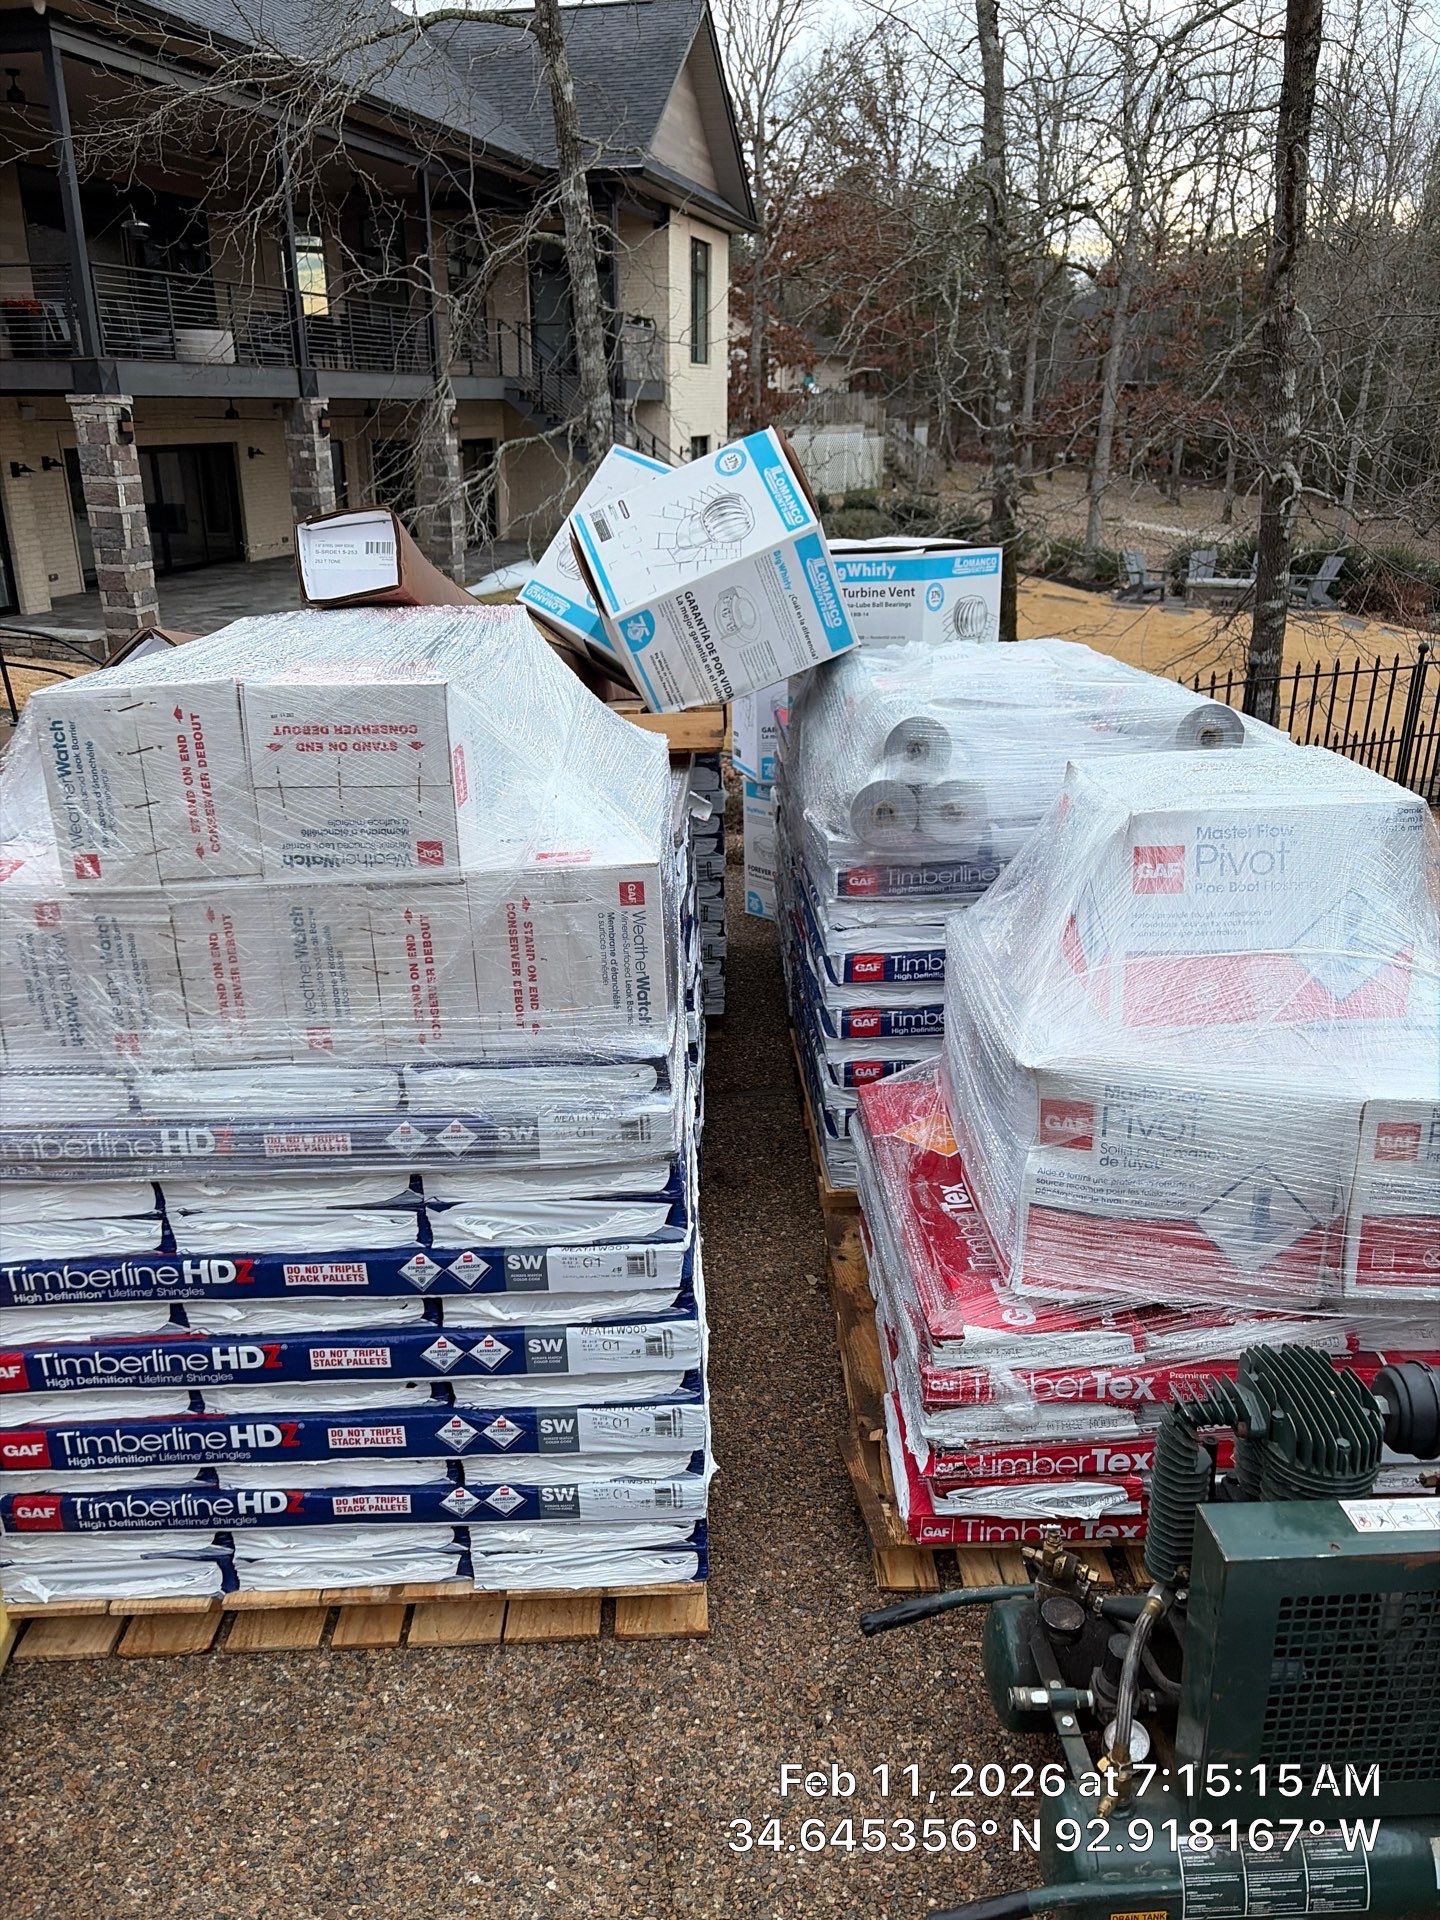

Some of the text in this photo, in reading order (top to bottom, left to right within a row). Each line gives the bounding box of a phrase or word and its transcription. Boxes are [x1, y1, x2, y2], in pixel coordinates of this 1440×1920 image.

[769, 465, 805, 524] LOMANCO
[954, 557, 997, 569] LOMANCO
[814, 557, 842, 628] LOMANCO
[842, 586, 916, 598] Turbine Vent
[526, 588, 567, 617] LOMANCO
[675, 594, 717, 684] La mejor garantía en el
[684, 591, 735, 701] GARANTÍA DE POR VIDA
[273, 724, 418, 736] CONSERVER DEBOUT
[68, 720, 84, 774] Leak Barrier
[296, 741, 398, 752] STAND ON END
[49, 719, 84, 850] WeatherWatch
[176, 734, 201, 834] STAND ON END
[190, 712, 221, 853] CONSERVER DEBOUT
[1257, 825, 1293, 838] Flow
[283, 852, 411, 868] WeatherWatch
[1194, 841, 1291, 877] Pivot
[886, 865, 1000, 885] Timberline
[1136, 863, 1184, 879] GAF
[849, 877, 876, 886] GAF
[1194, 882, 1260, 894] Pipe Boot
[627, 883, 638, 904] GAF
[888, 887, 906, 895] High
[222, 913, 238, 964] DEBOUT
[607, 912, 620, 957] Membrane
[208, 932, 224, 980] ON END
[405, 933, 419, 981] ON END
[506, 902, 525, 1029] CONSERVER DEBOUT
[523, 921, 540, 1011] STAND ON END
[632, 910, 653, 1027] WeatherWatch
[855, 963, 881, 973] GAF
[420, 914, 442, 1041] CONSERVER DEBOUT
[894, 972, 912, 981] High
[625, 979, 634, 999] Leak
[852, 1018, 879, 1028] GAF
[891, 1027, 909, 1035] High
[854, 1067, 881, 1077] GAF
[1044, 1115, 1091, 1131] GAF
[283, 1133, 347, 1144] NOT TRIPLE
[498, 1126, 535, 1142] SW
[1100, 1157, 1119, 1168] de
[1037, 1167, 1057, 1176] Aide
[1036, 1178, 1065, 1188] source
[286, 1263, 364, 1275] DO NOT TRIPLE
[507, 1254, 544, 1270] SW
[582, 1256, 601, 1268] 01
[287, 1272, 365, 1283] STACK PALLETS
[13, 1292, 42, 1305] High
[156, 1286, 205, 1297] Shingles
[528, 1338, 564, 1353] SW
[602, 1340, 620, 1351] 01
[312, 1348, 388, 1359] DO NOT TRIPLE
[313, 1356, 388, 1367] STACK PALLETS
[45, 1377, 74, 1389] High
[186, 1372, 234, 1384] Shingles
[930, 1380, 957, 1391] GAF
[540, 1418, 575, 1434] SW
[612, 1417, 630, 1429] 01
[331, 1427, 403, 1438] DO NOT TRIPLE
[331, 1436, 404, 1446] STACK PALLETS
[5, 1444, 44, 1458] GAF
[68, 1455, 95, 1467] High
[205, 1450, 251, 1461] Shingles
[936, 1461, 965, 1473] GAF
[335, 1495, 408, 1507] DO NOT TRIPLE
[541, 1487, 575, 1502] SW
[613, 1488, 630, 1500] 01
[16, 1506, 56, 1519] GAF
[336, 1503, 409, 1513] STACK PALLETS
[79, 1519, 106, 1530] High
[212, 1515, 258, 1526] Shingles
[923, 1526, 951, 1538] GAF
